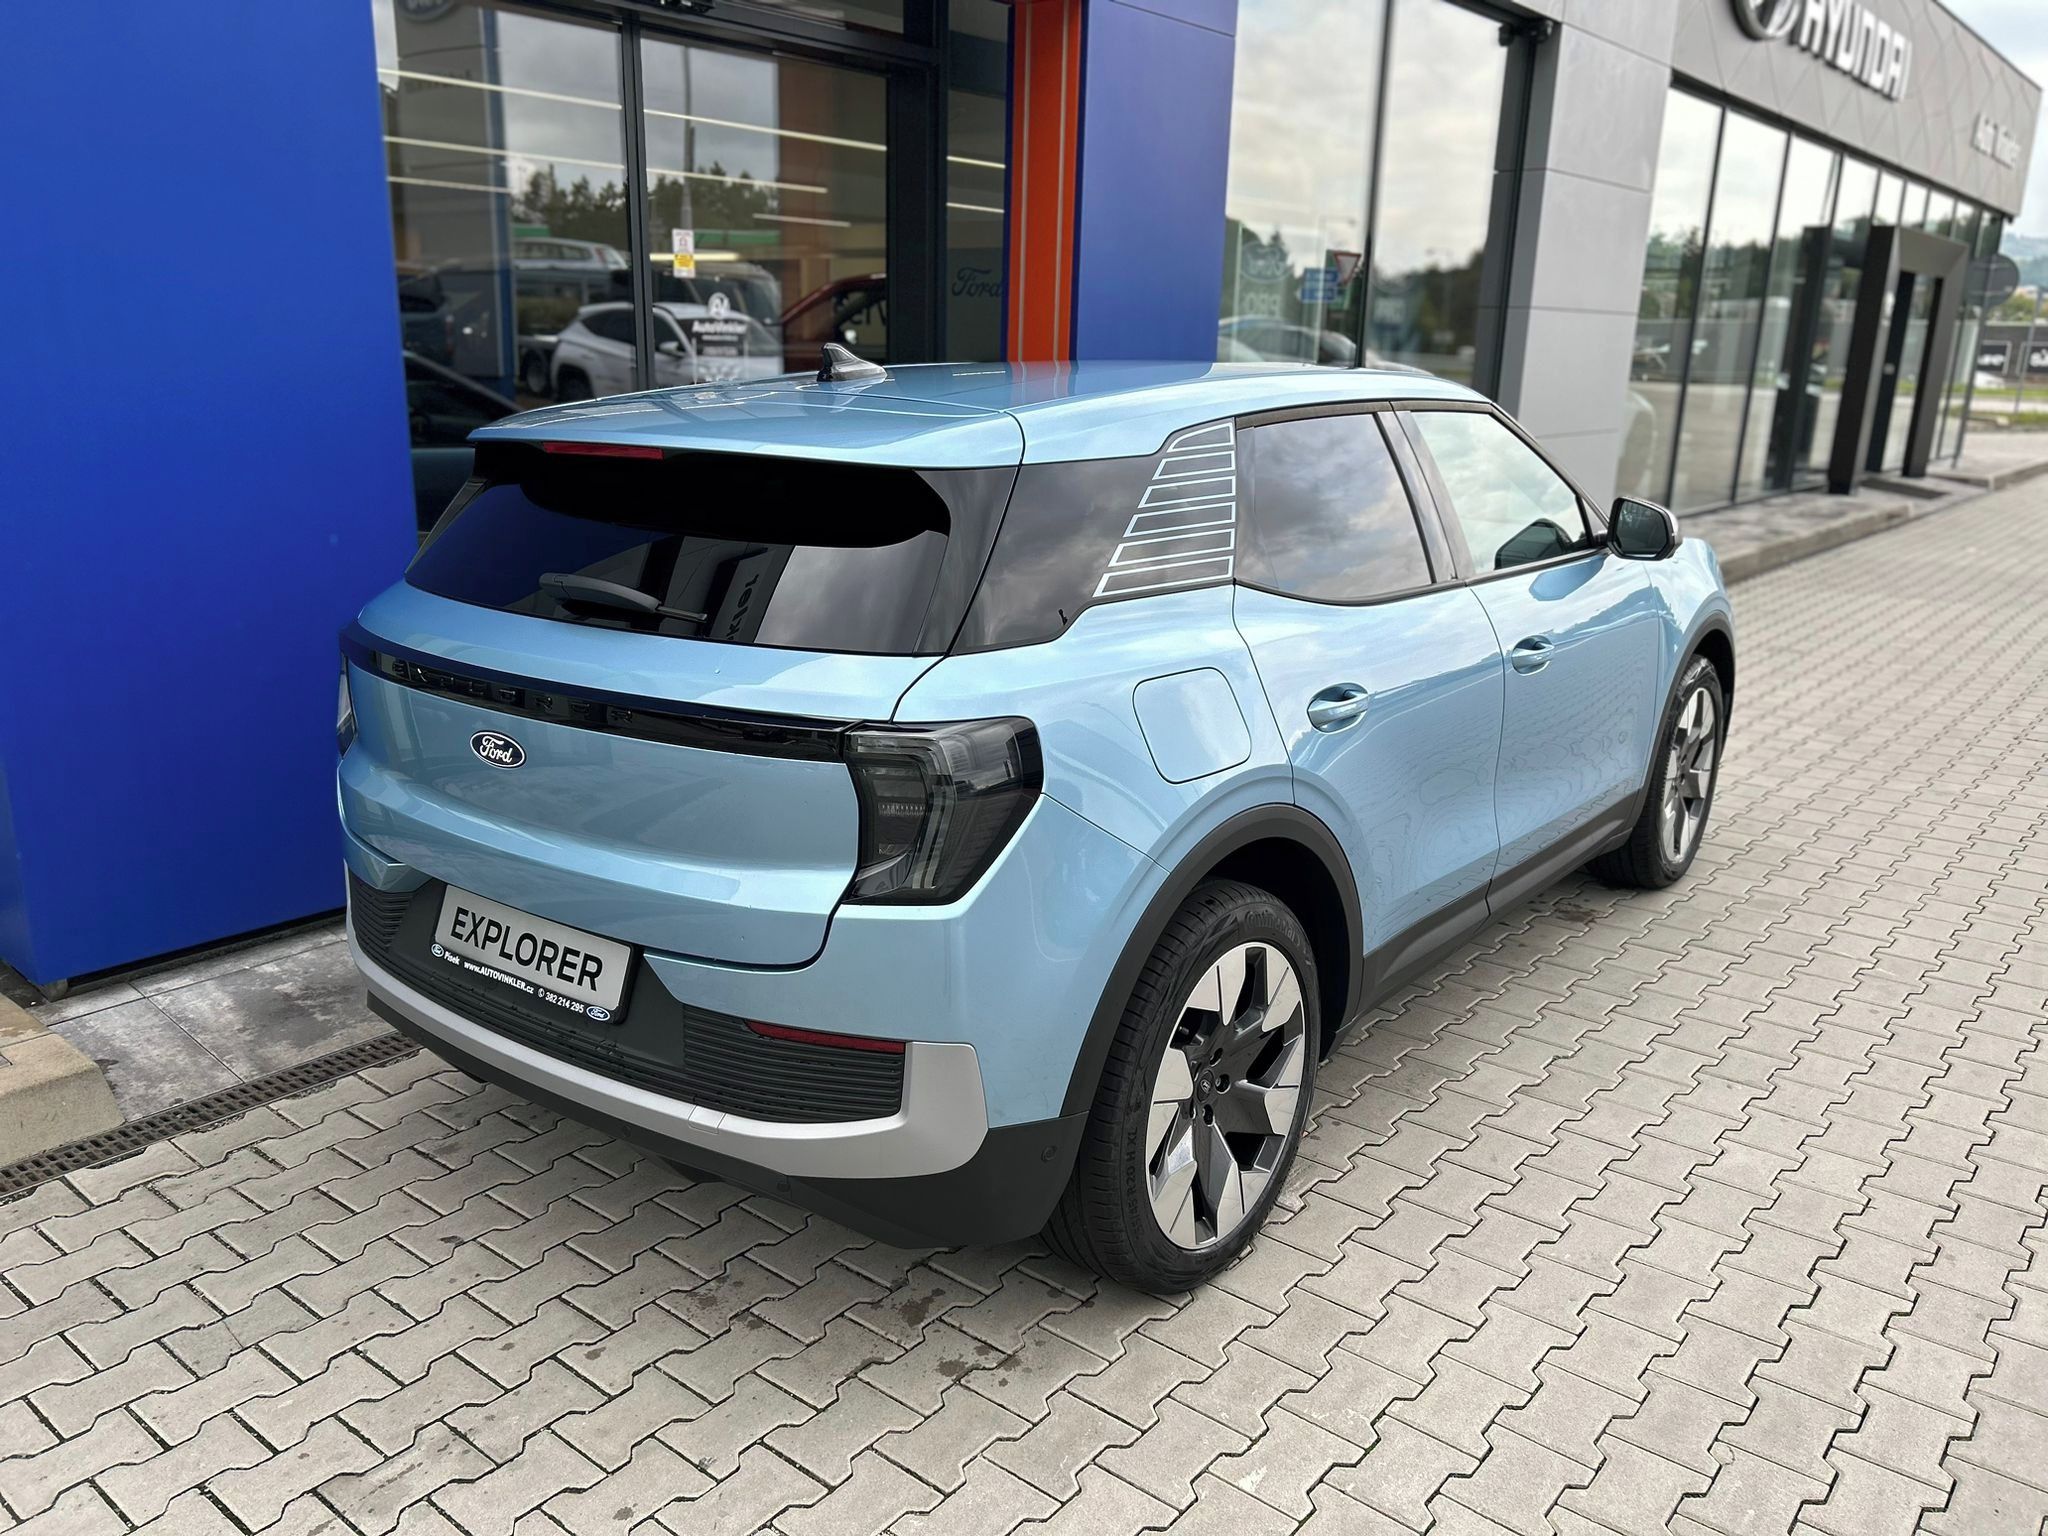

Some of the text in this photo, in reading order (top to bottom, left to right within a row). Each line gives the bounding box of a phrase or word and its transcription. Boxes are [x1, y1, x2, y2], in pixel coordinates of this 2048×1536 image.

[1800, 0, 1912, 101] HYUNDAI
[480, 735, 513, 763] Ford
[450, 906, 604, 991] EXPLORER
[464, 961, 534, 994] www.AUTOVINKLER.cz
[545, 991, 558, 1004] 382
[557, 996, 571, 1009] 214
[570, 1001, 585, 1014] 295
